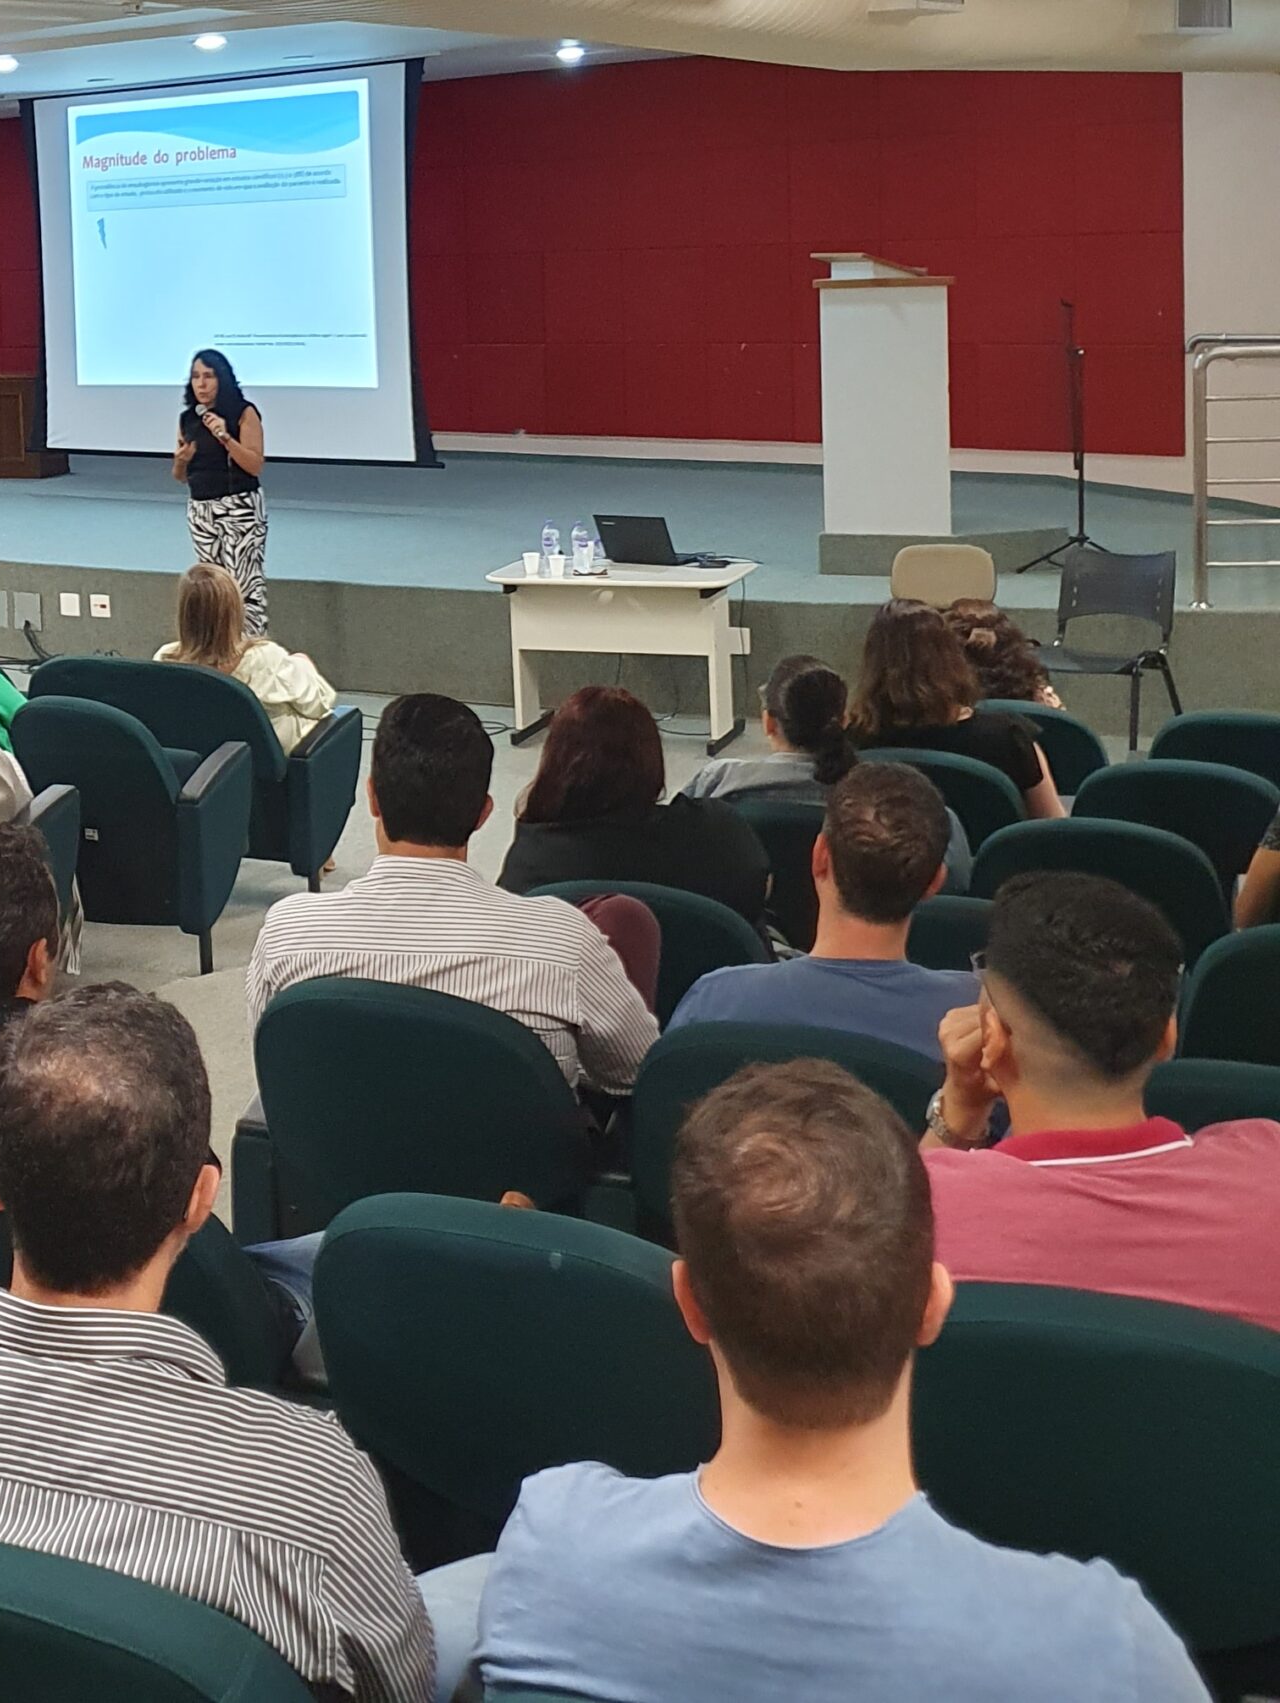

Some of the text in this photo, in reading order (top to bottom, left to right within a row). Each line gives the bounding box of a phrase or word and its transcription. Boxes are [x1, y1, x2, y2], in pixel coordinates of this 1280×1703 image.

[82, 146, 237, 172] Magnitude do problema
